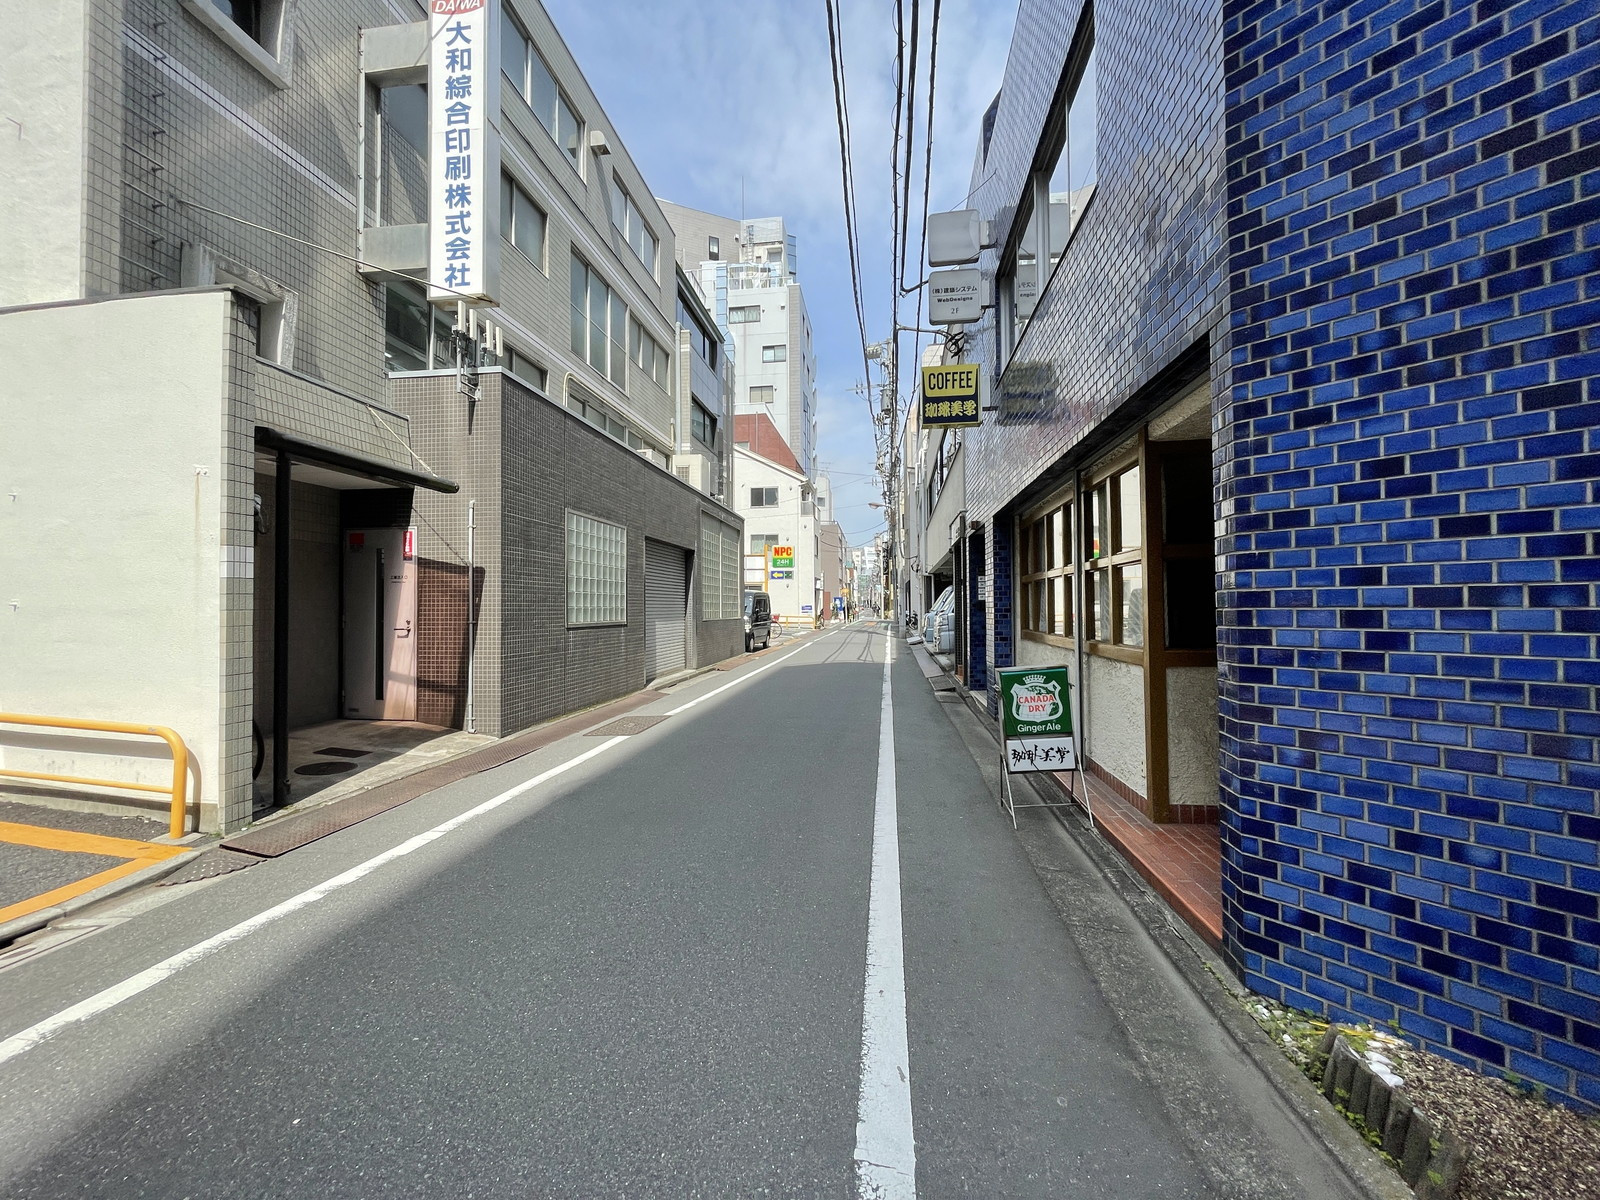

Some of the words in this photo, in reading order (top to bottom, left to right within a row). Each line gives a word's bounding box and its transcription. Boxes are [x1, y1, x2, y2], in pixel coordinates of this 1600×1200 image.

[434, 0, 480, 12] DAIWA
[444, 21, 472, 288] 大和綜合印刷株式会社
[928, 371, 973, 390] COFFEE
[774, 546, 792, 556] NPC
[1018, 694, 1055, 704] CANADA
[1028, 704, 1046, 712] DRY
[1017, 723, 1046, 733] Ginger
[1046, 722, 1061, 731] Ale
